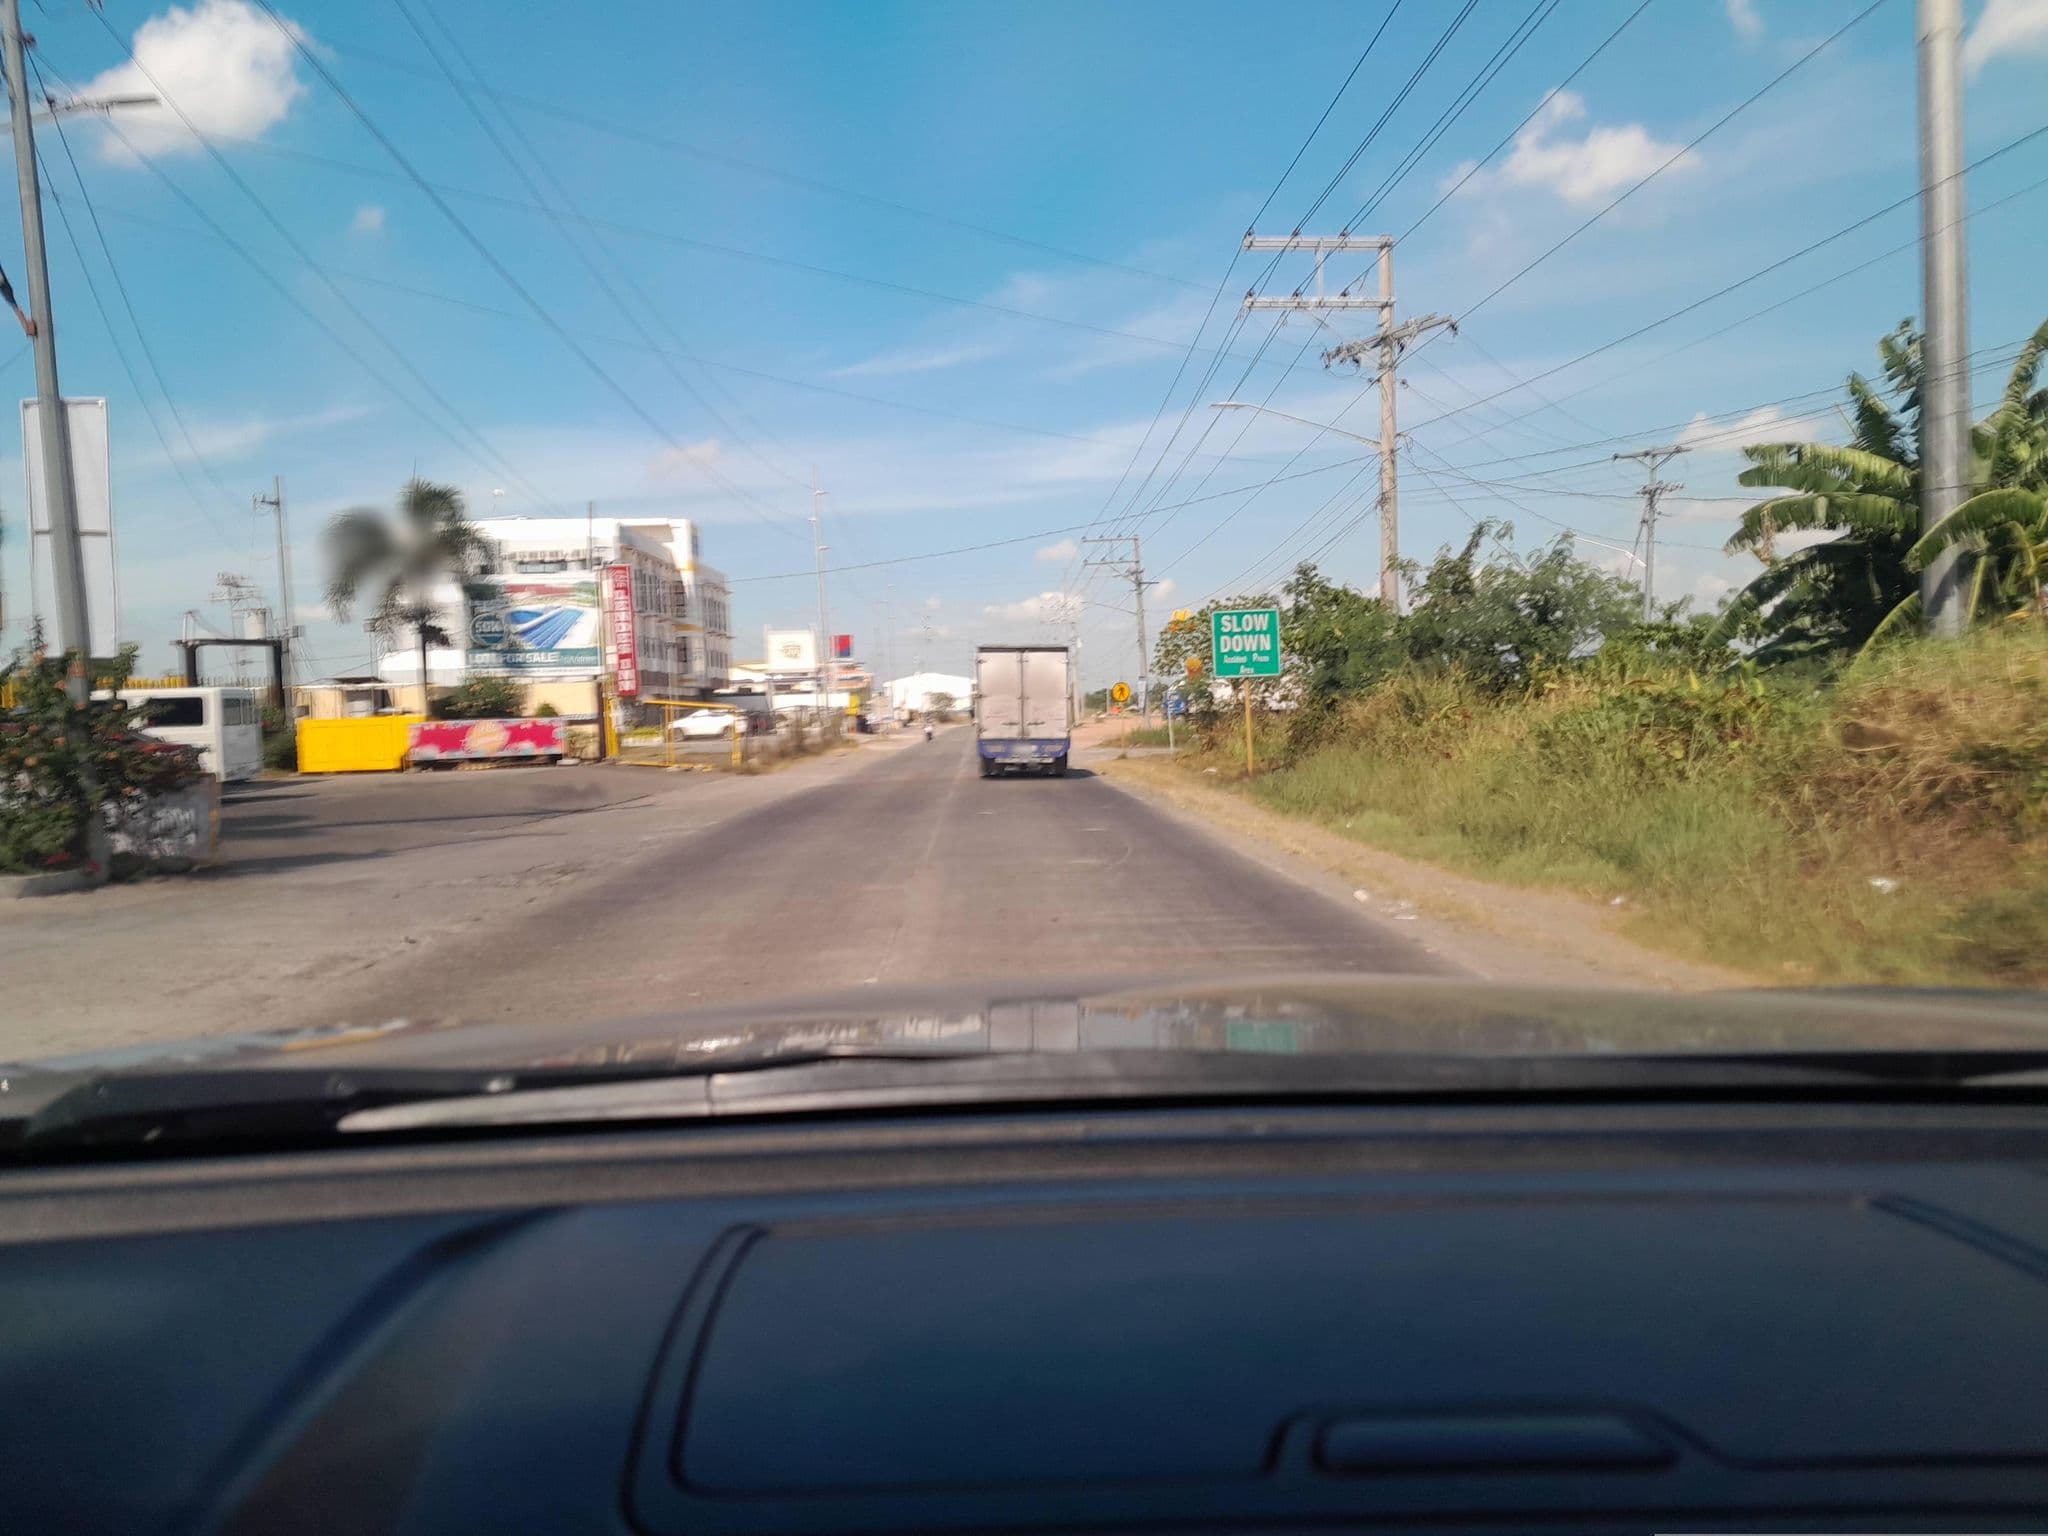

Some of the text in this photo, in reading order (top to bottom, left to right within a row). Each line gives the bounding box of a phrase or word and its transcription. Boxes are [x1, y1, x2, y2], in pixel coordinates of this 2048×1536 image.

[1221, 613, 1269, 632] SLOW
[1220, 634, 1271, 653] DOWN
[525, 651, 559, 663] SALE
